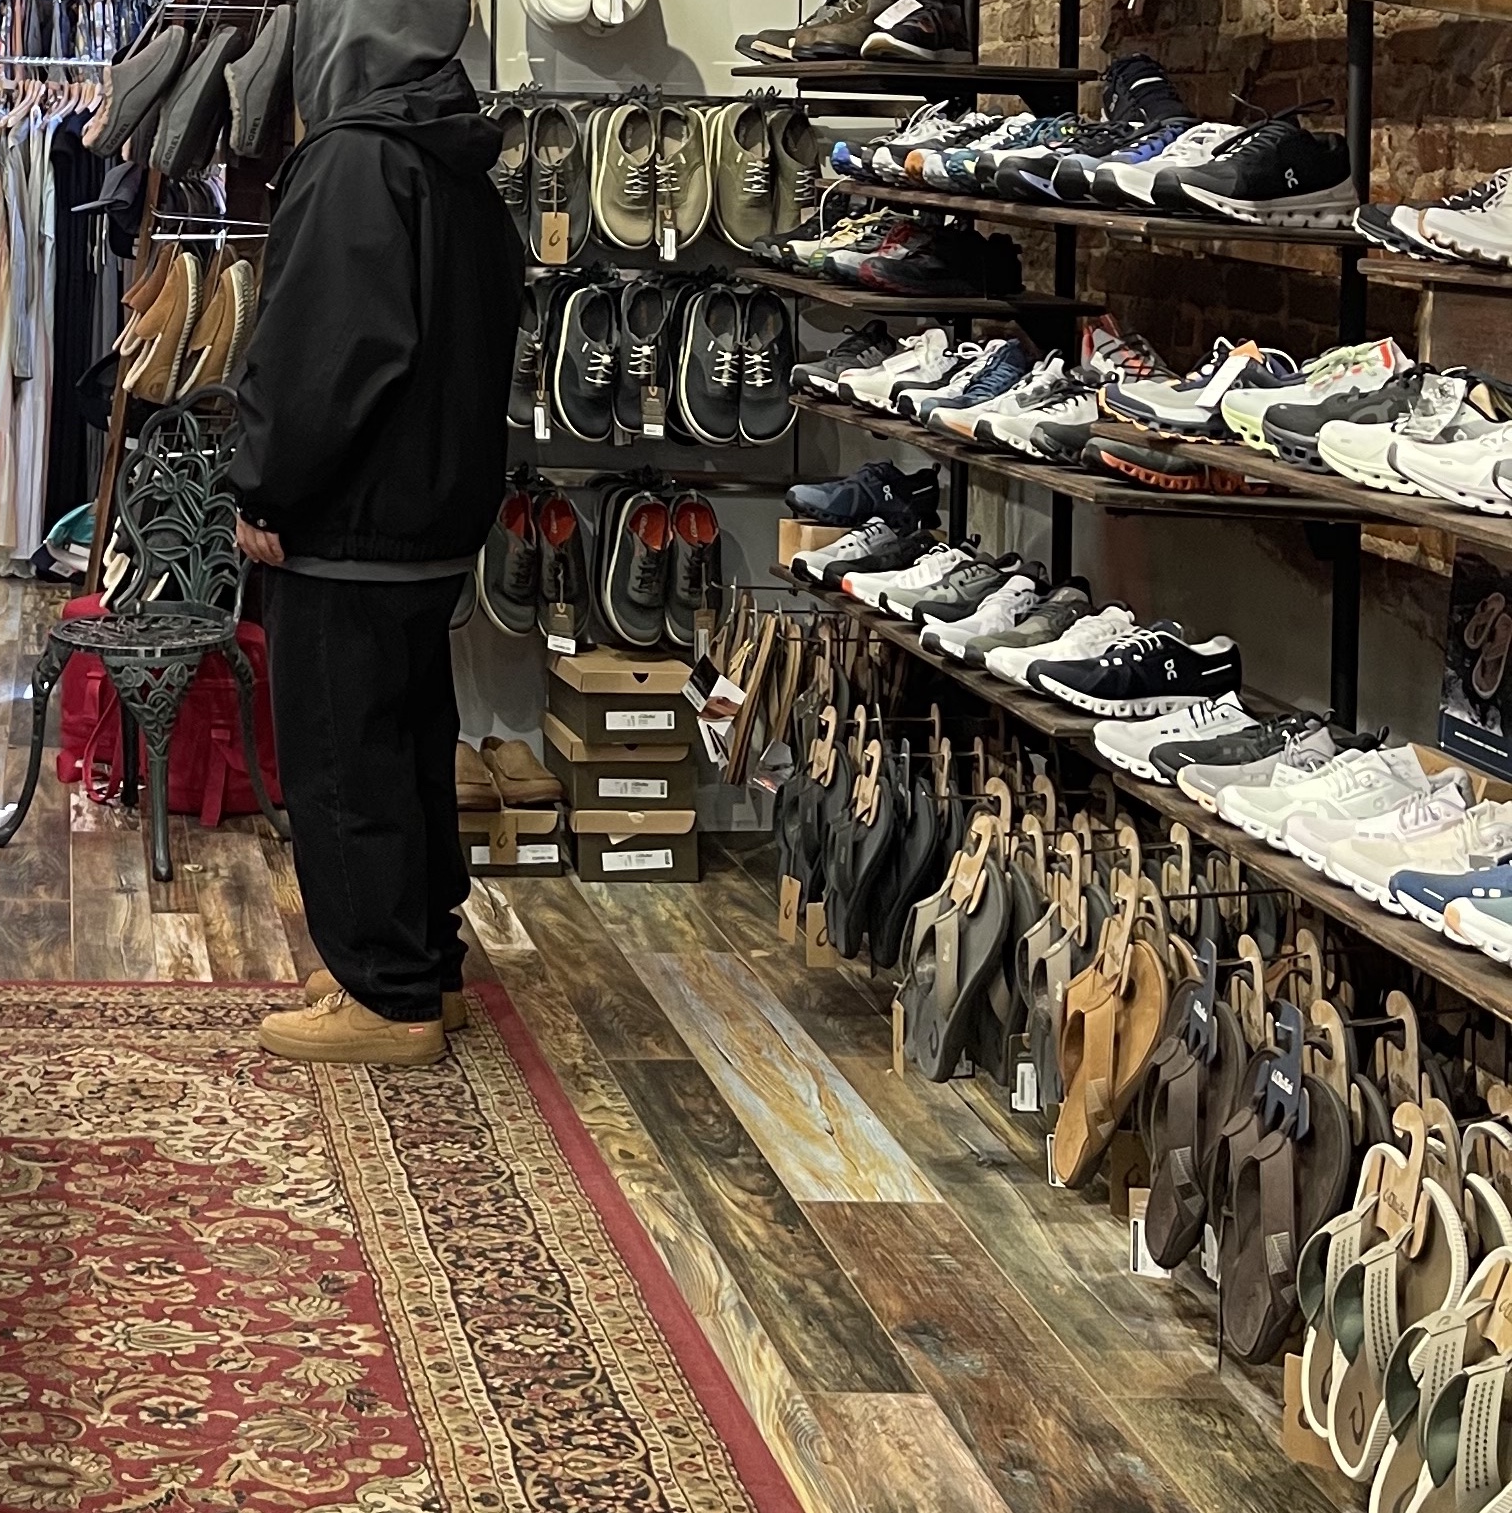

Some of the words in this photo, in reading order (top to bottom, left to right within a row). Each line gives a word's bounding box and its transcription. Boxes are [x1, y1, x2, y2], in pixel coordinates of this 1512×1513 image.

[106, 122, 131, 150] SOREL
[246, 116, 262, 147] SOREL
[162, 133, 182, 168] SOREL
